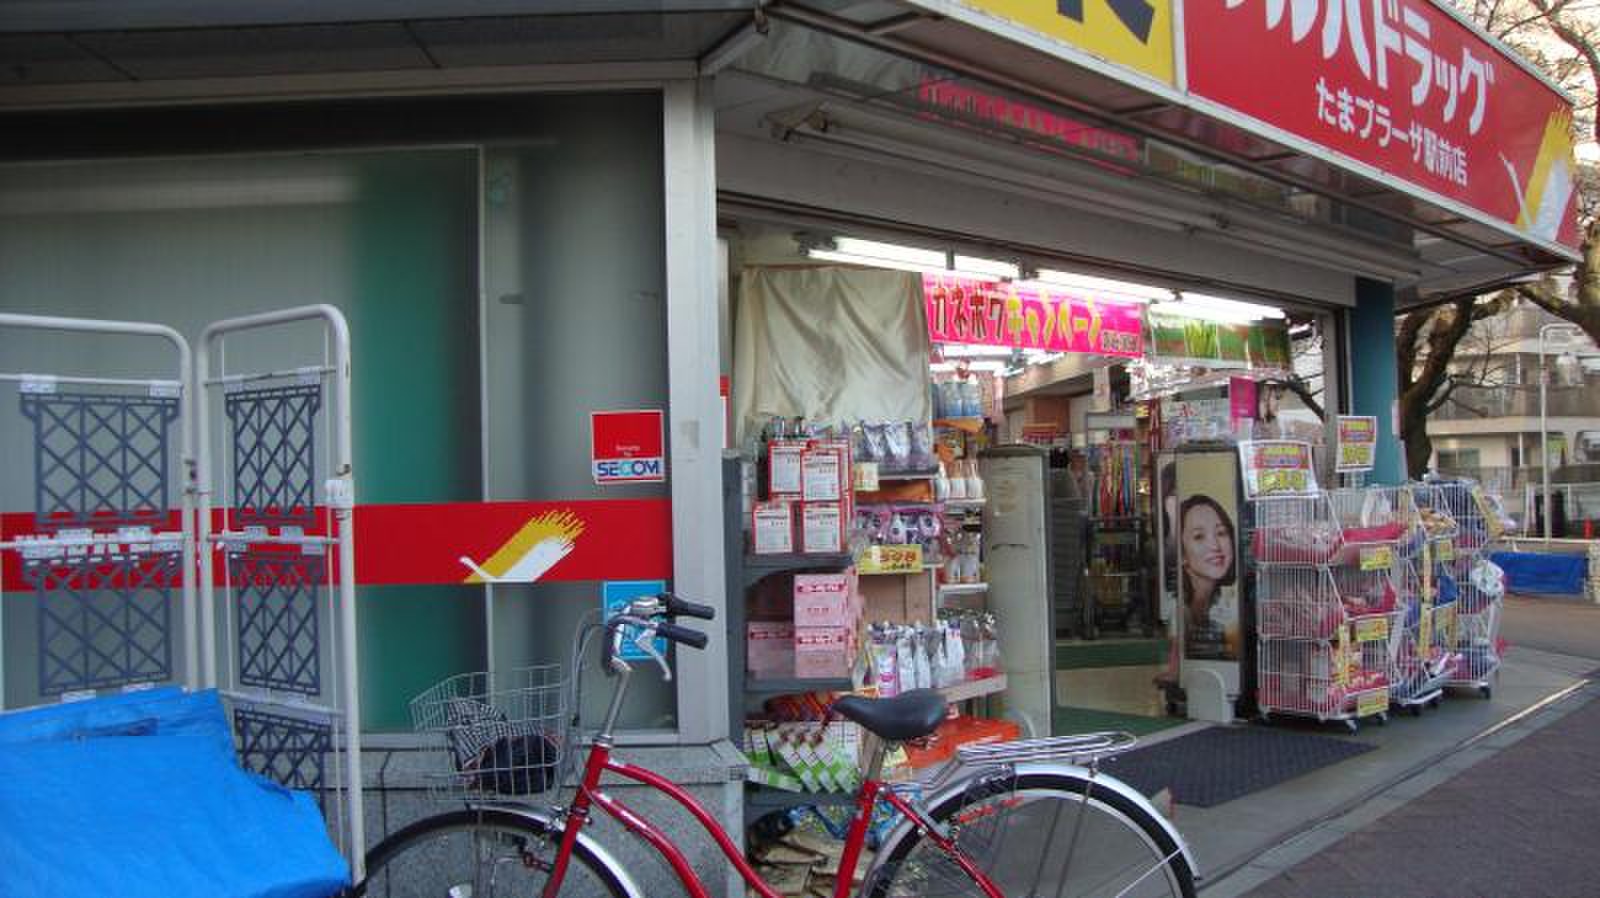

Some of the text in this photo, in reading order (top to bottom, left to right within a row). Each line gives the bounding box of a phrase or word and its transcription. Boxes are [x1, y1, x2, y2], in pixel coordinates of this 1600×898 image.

[1315, 76, 1468, 187] たまプラーザ駅前店
[597, 460, 659, 477] SECOM
